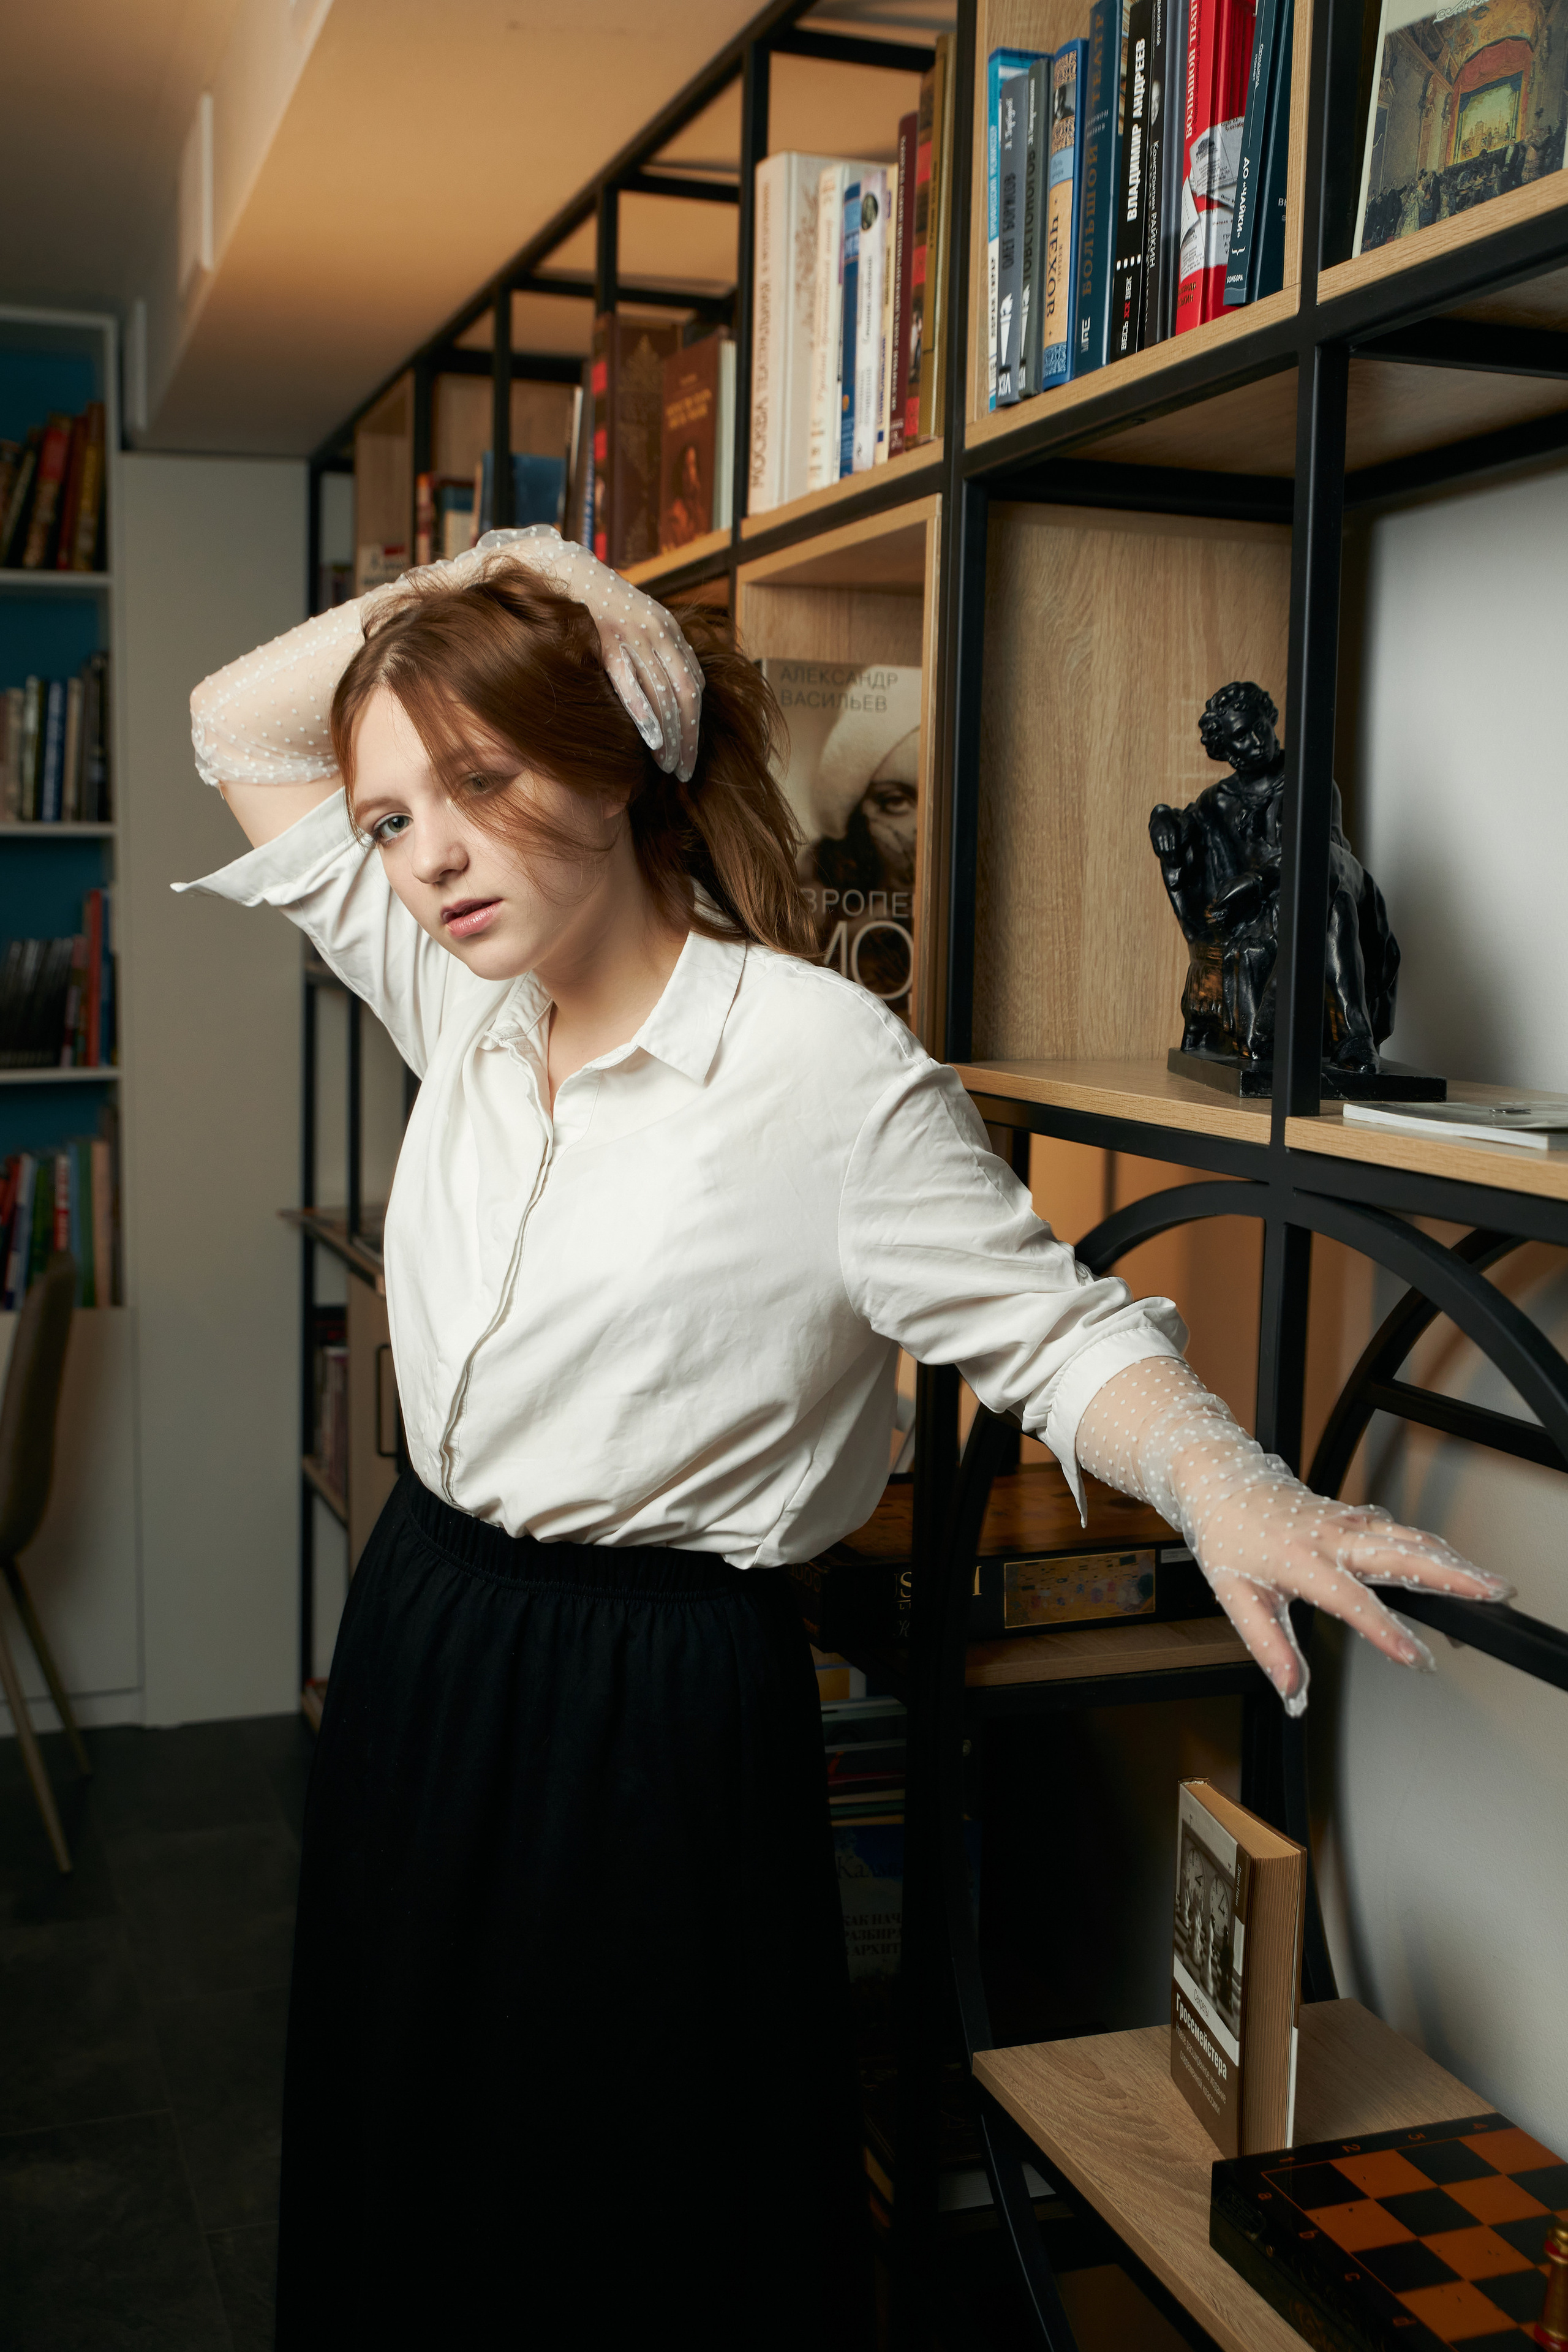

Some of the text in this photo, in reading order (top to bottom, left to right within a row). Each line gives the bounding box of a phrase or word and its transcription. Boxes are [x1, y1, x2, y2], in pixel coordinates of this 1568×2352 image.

[1185, 48, 1196, 140] БОЛЬШОЙ
[1127, 37, 1145, 222] ВЛАДИМИР АНДРЕЕВ
[1082, 13, 1104, 297] БОЛЬШОЙ ТЕАТР
[1237, 156, 1250, 239] ДО «ЧАЙКИ»
[1149, 212, 1158, 268] РАЙКИН
[1046, 214, 1058, 317] ЧЕХОВ
[1226, 274, 1243, 284] БОМБОРА
[780, 665, 899, 690] АЛЕКСАНДР
[780, 688, 888, 714] ВАСИЛЬЕВ
[800, 889, 909, 918] ВРОПЕ
[872, 1912, 902, 1926] НАЧ
[852, 1942, 901, 1956] АРХИТ
[1194, 1988, 1210, 2019] Секреты
[1176, 1992, 1227, 2081] Гроссмейстера
[1176, 2021, 1186, 2049] Новое
[1209, 2074, 1226, 2105] издание
[1202, 2084, 1220, 2116] классики
